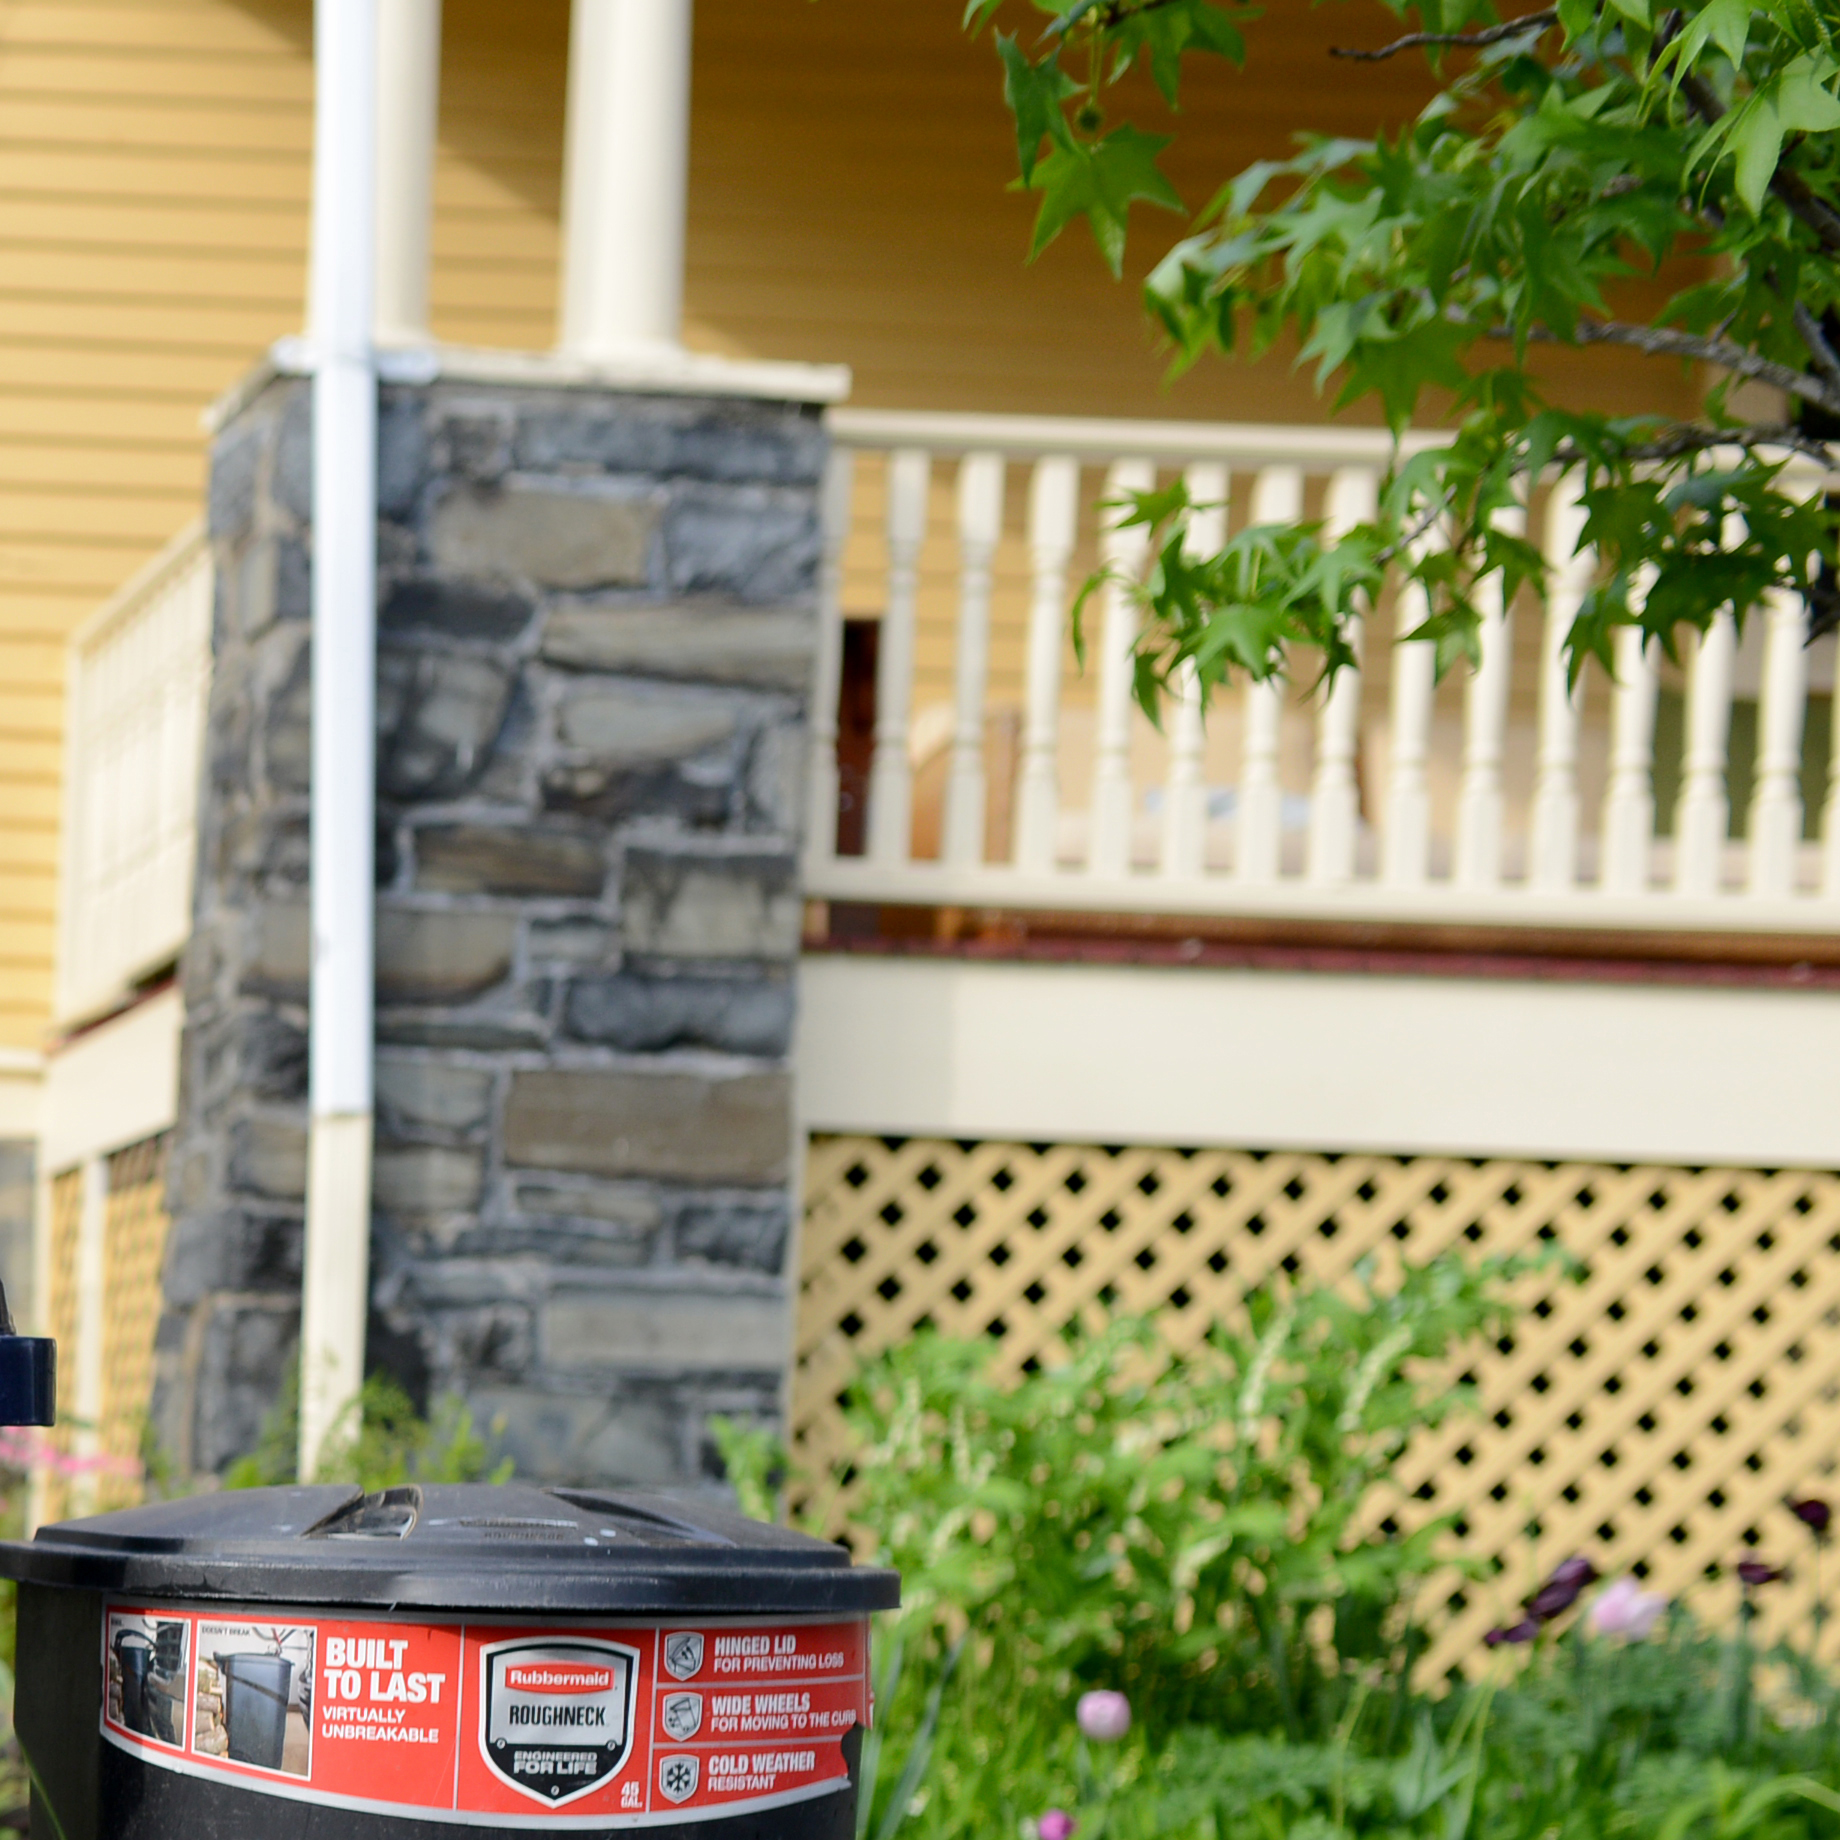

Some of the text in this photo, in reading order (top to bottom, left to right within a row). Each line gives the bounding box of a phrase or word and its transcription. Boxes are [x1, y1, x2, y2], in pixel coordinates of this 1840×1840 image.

[326, 1636, 408, 1670] BUILT
[714, 1634, 796, 1657] HINGED LID
[714, 1651, 844, 1673] FOR PREVENTING LOSS
[323, 1669, 446, 1704] TO LAST
[510, 1670, 609, 1686] Rubbermaid
[322, 1705, 406, 1724] VIRTUALLY
[711, 1692, 811, 1716] WIDE WHEELS
[509, 1705, 607, 1726] ROUGHNECK
[711, 1708, 857, 1732] FOR MOVING TO THE CURB
[322, 1723, 439, 1743] UNBREAKABLE
[514, 1750, 598, 1762] ENGINEERED
[708, 1751, 816, 1775] COLD WEATHER
[513, 1761, 598, 1775] FOR LIFE
[621, 1781, 640, 1795] 45
[707, 1774, 776, 1792] RESISTANT
